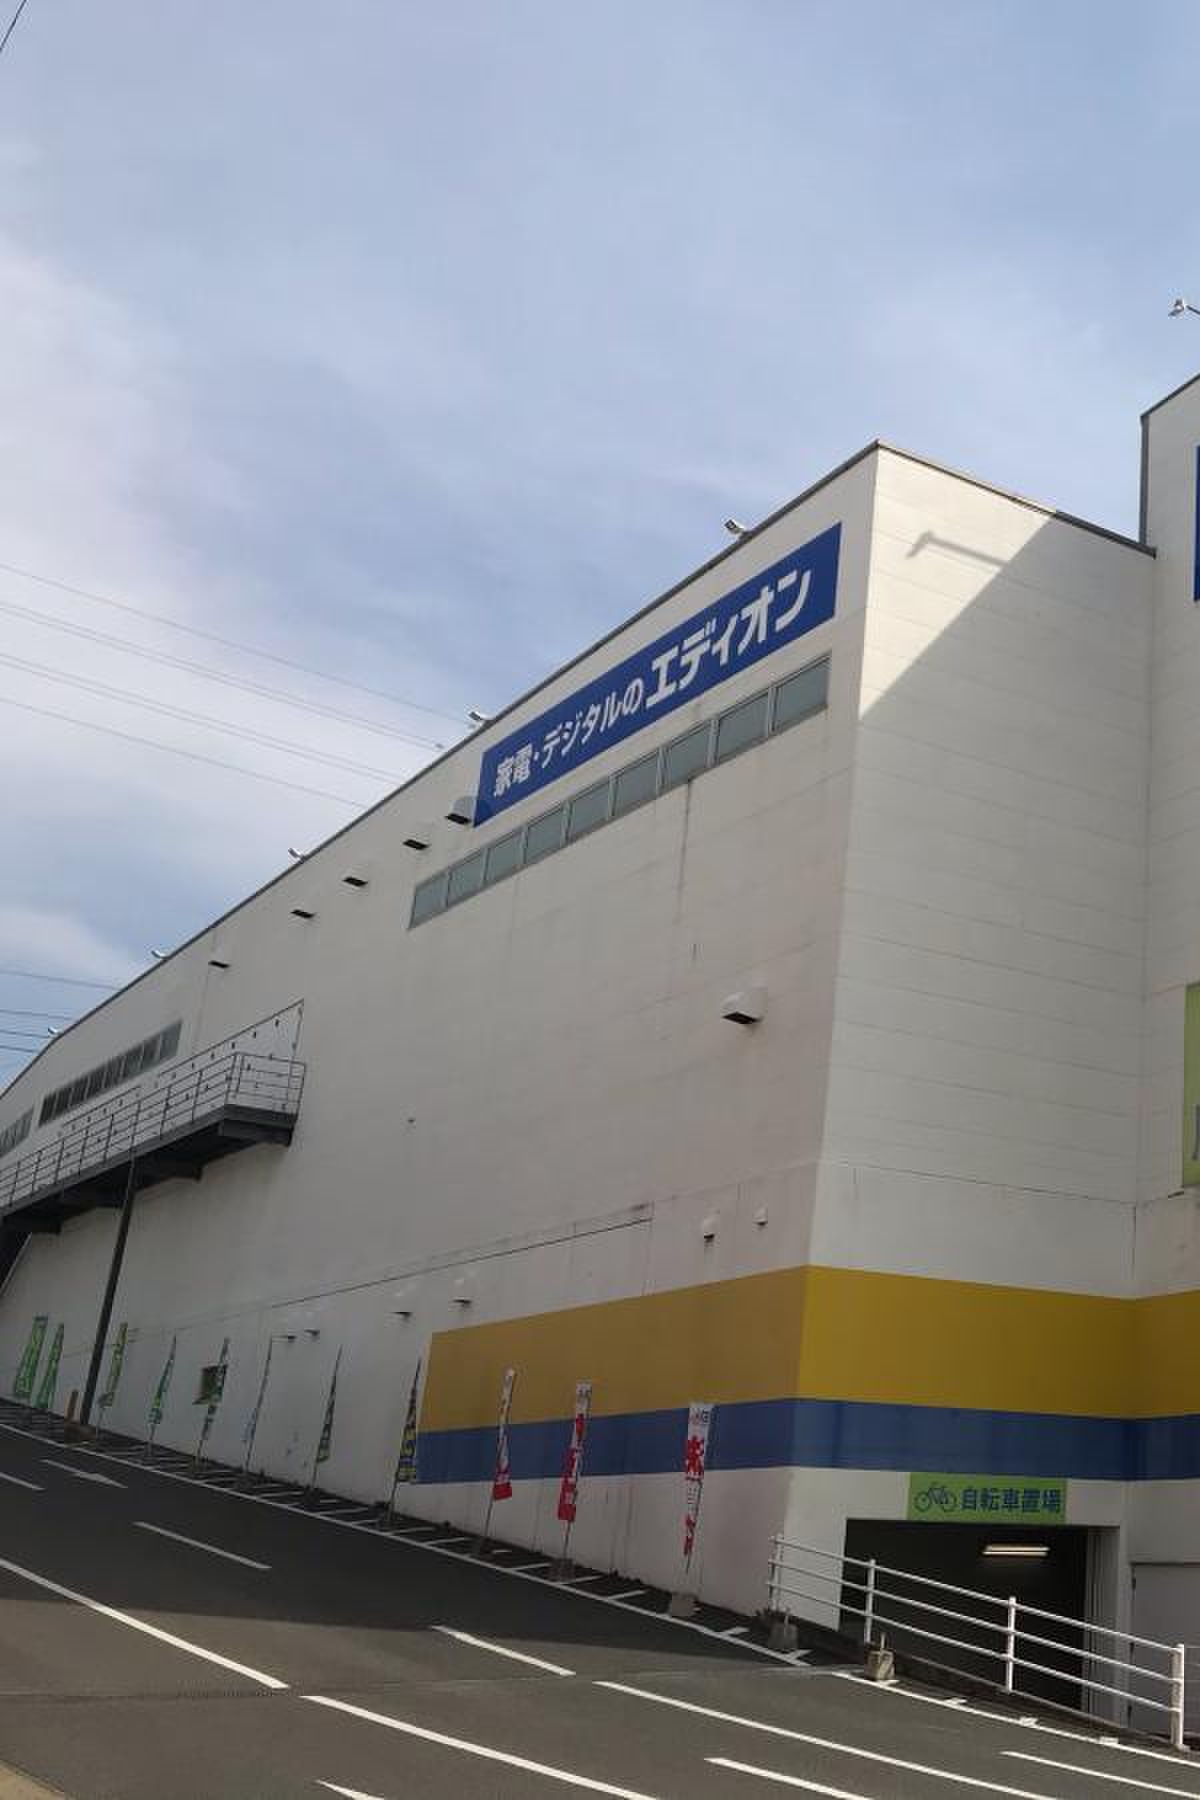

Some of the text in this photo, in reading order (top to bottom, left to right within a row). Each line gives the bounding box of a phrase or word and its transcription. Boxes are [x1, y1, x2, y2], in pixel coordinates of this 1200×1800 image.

[959, 1486, 1062, 1514] 自転車置場
